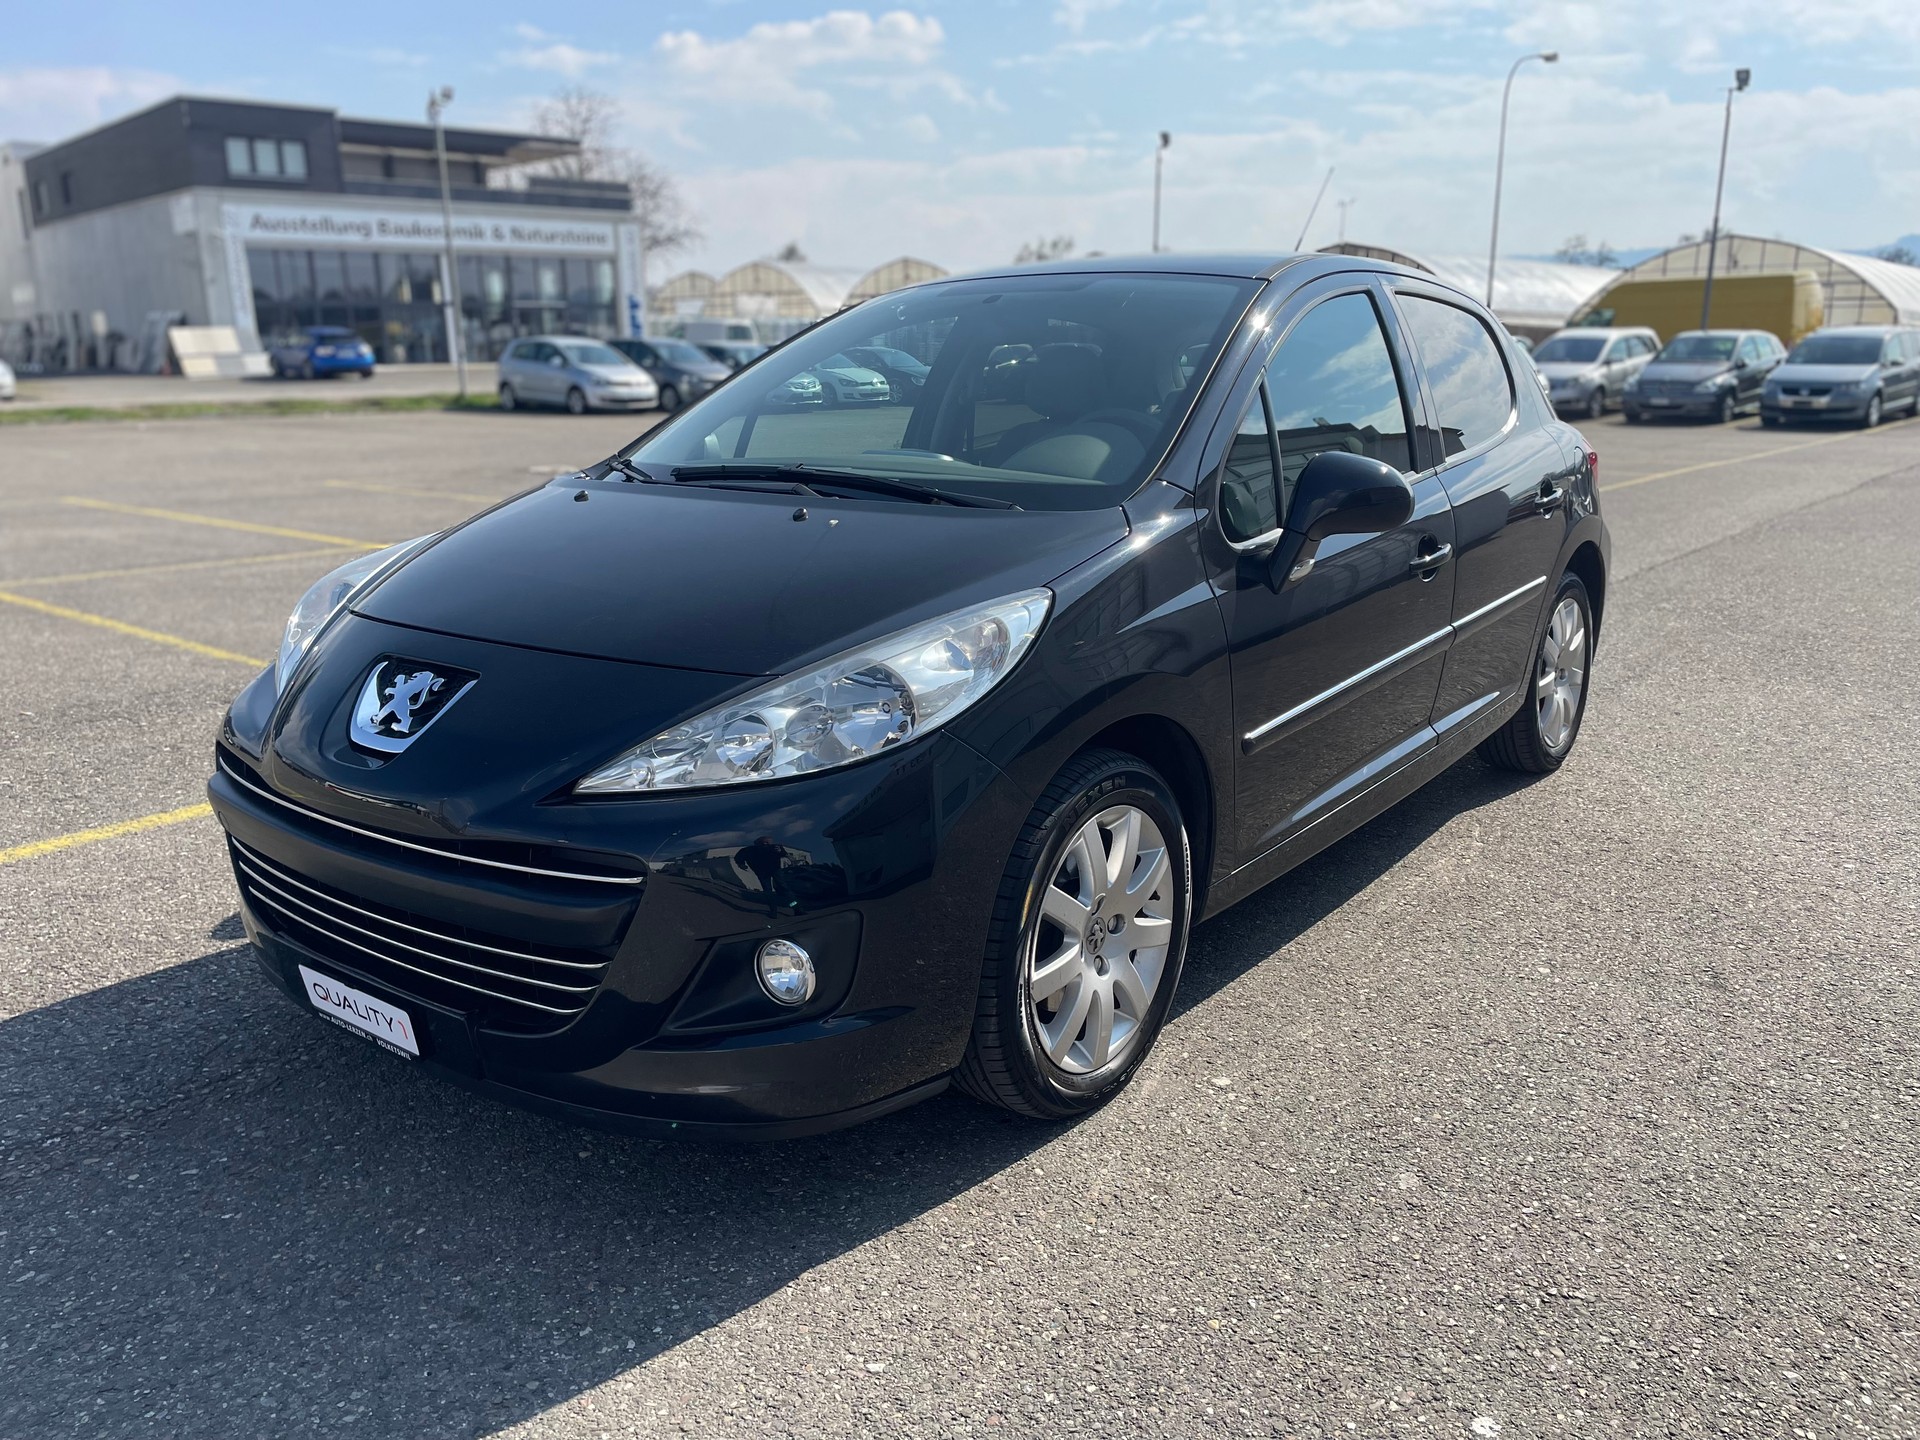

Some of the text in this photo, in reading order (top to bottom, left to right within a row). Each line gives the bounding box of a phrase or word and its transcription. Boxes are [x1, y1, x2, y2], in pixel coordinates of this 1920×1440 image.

[251, 213, 373, 240] Ausstellung
[376, 218, 485, 240] Baukermik
[492, 224, 505, 241] &
[1062, 775, 1127, 832] NEXEN
